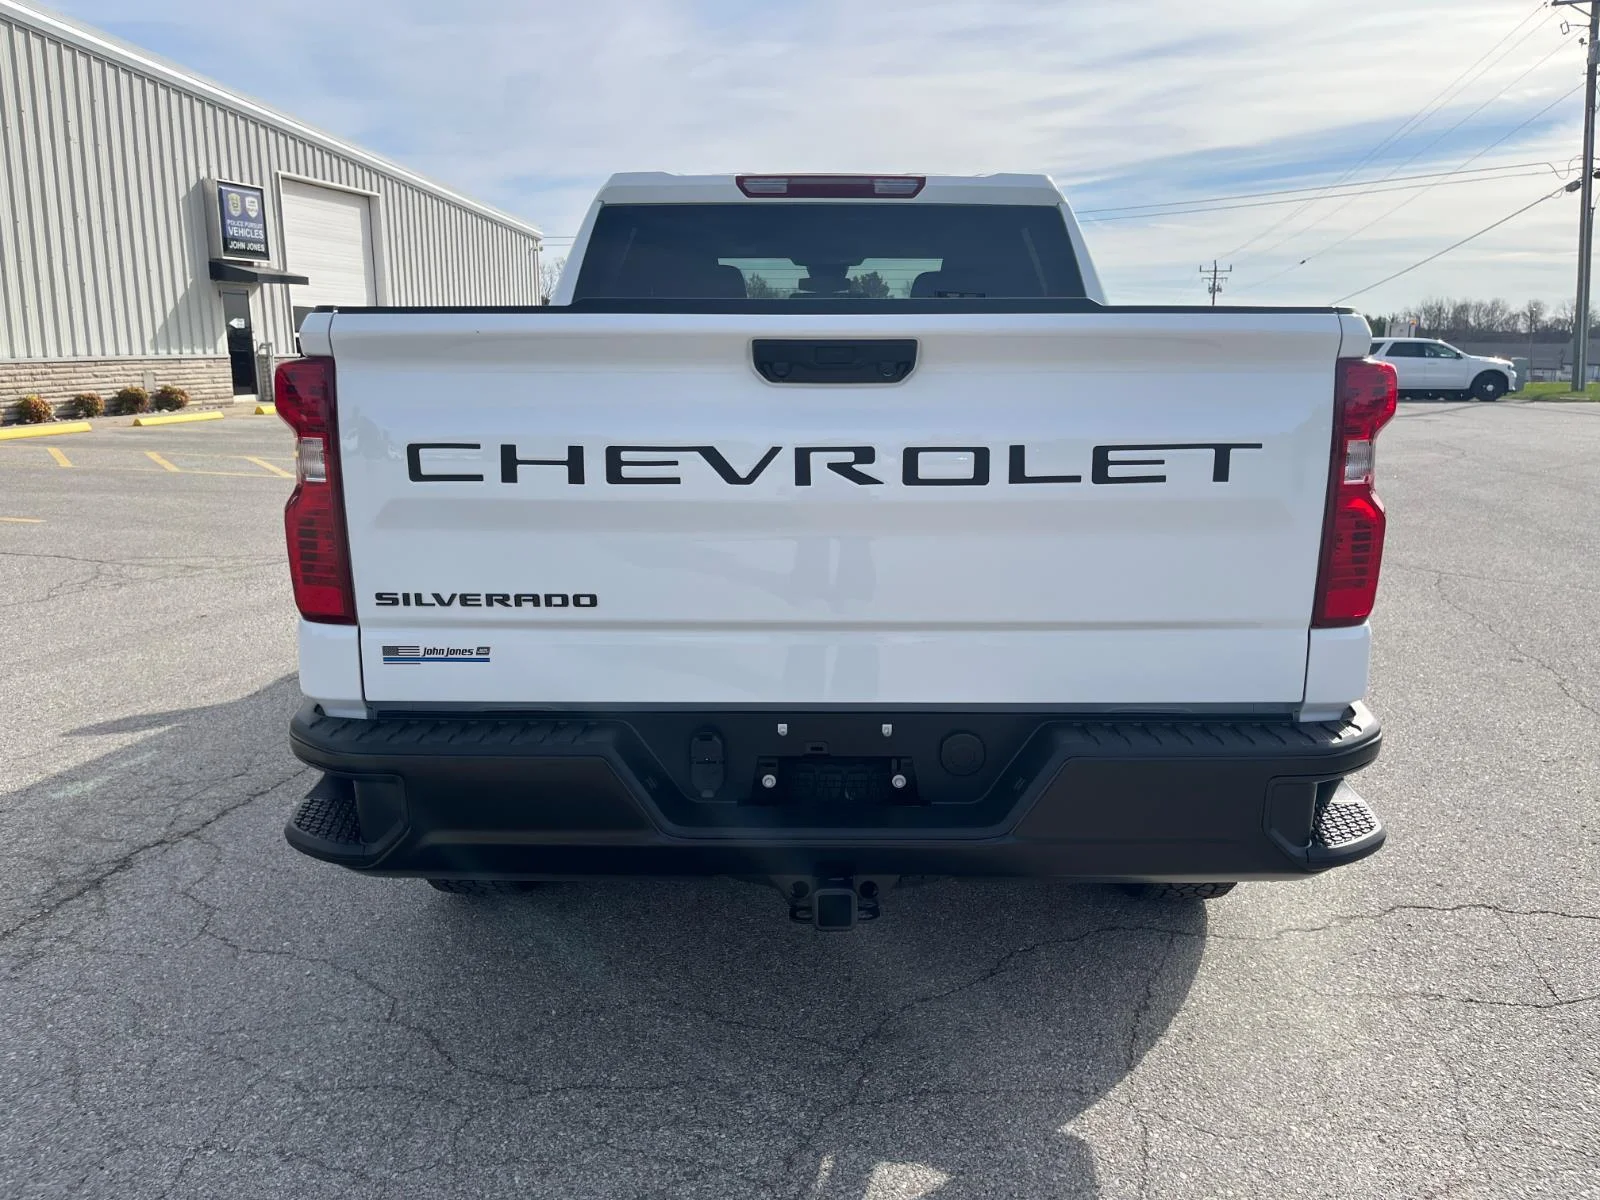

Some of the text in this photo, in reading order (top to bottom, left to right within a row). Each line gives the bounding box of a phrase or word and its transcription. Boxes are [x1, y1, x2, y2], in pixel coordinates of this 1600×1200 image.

[226, 219, 263, 229] POLICE PURSUIT
[227, 226, 264, 239] VEHICLES
[229, 241, 265, 252] JOHN JONES
[406, 443, 1263, 486] CHEVROLET
[375, 592, 598, 608] SILVERADO
